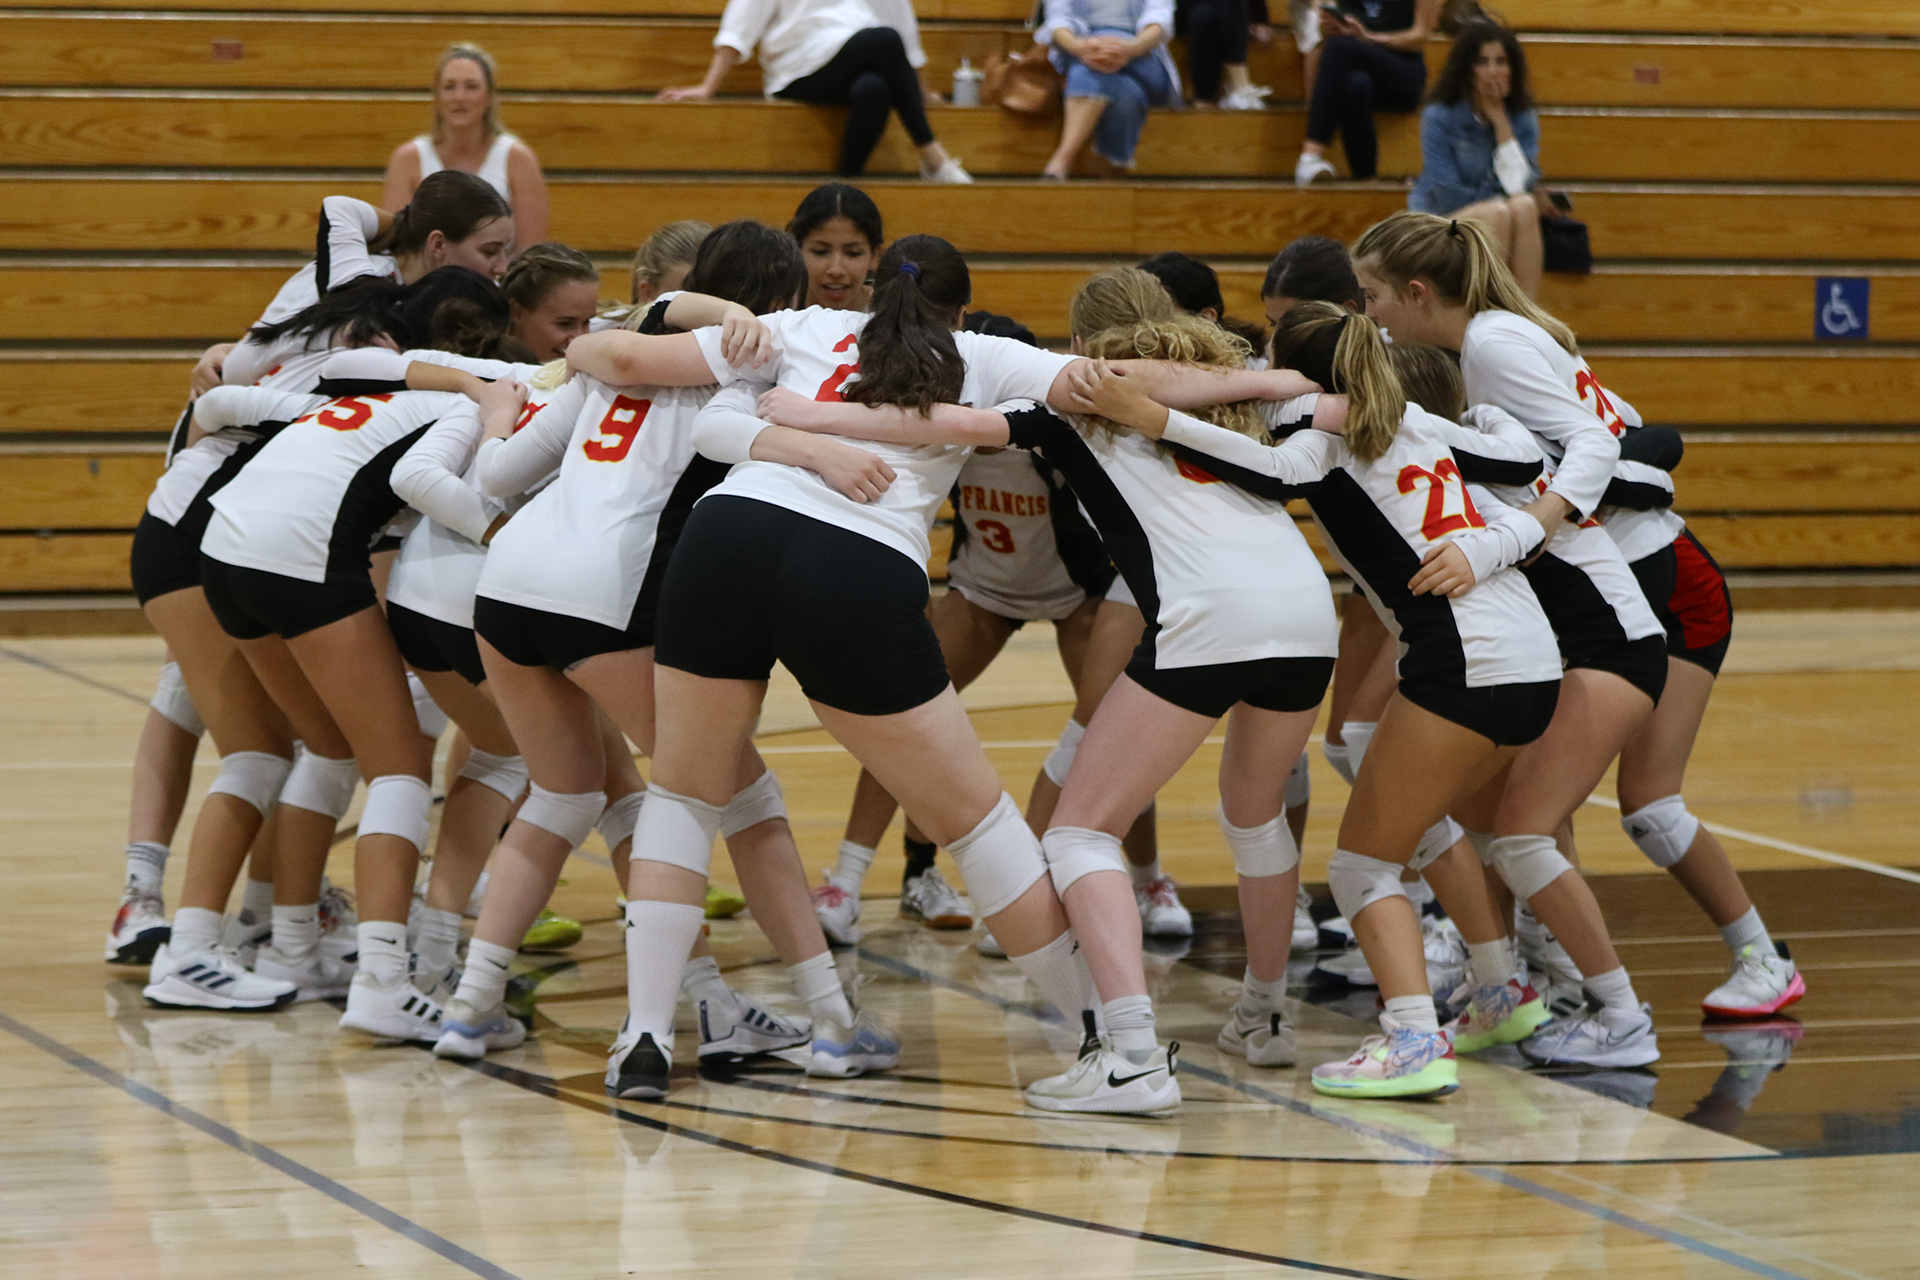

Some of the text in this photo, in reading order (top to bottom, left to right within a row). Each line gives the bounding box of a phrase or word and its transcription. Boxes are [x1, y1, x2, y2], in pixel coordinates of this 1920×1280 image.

[582, 393, 653, 463] 9
[961, 484, 1047, 517] FRANCIS
[1396, 456, 1487, 543] 22
[974, 519, 1016, 554] 3
